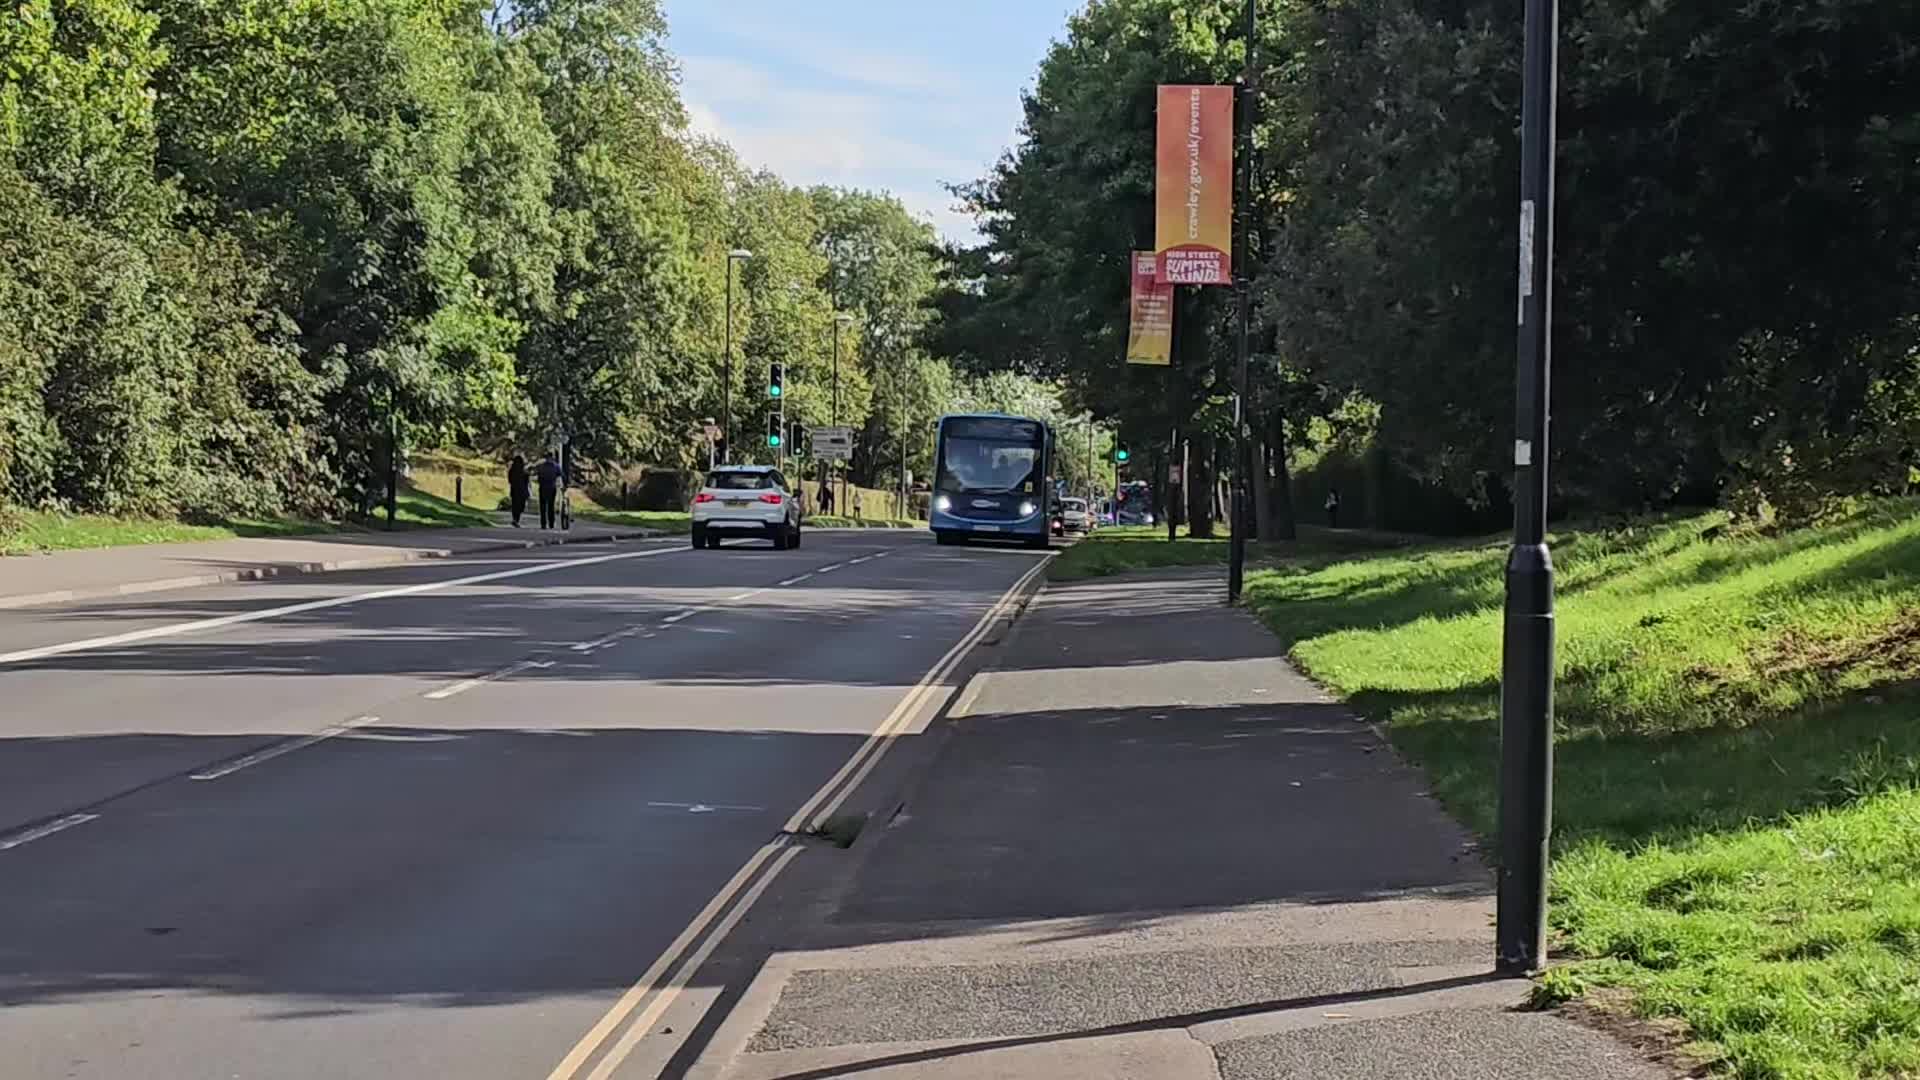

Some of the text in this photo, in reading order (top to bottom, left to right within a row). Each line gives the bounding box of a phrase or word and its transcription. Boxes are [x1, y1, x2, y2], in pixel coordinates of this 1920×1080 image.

[1185, 88, 1203, 240] crawley.gov.uk/events
[1166, 251, 1220, 259] HIGH STREET
